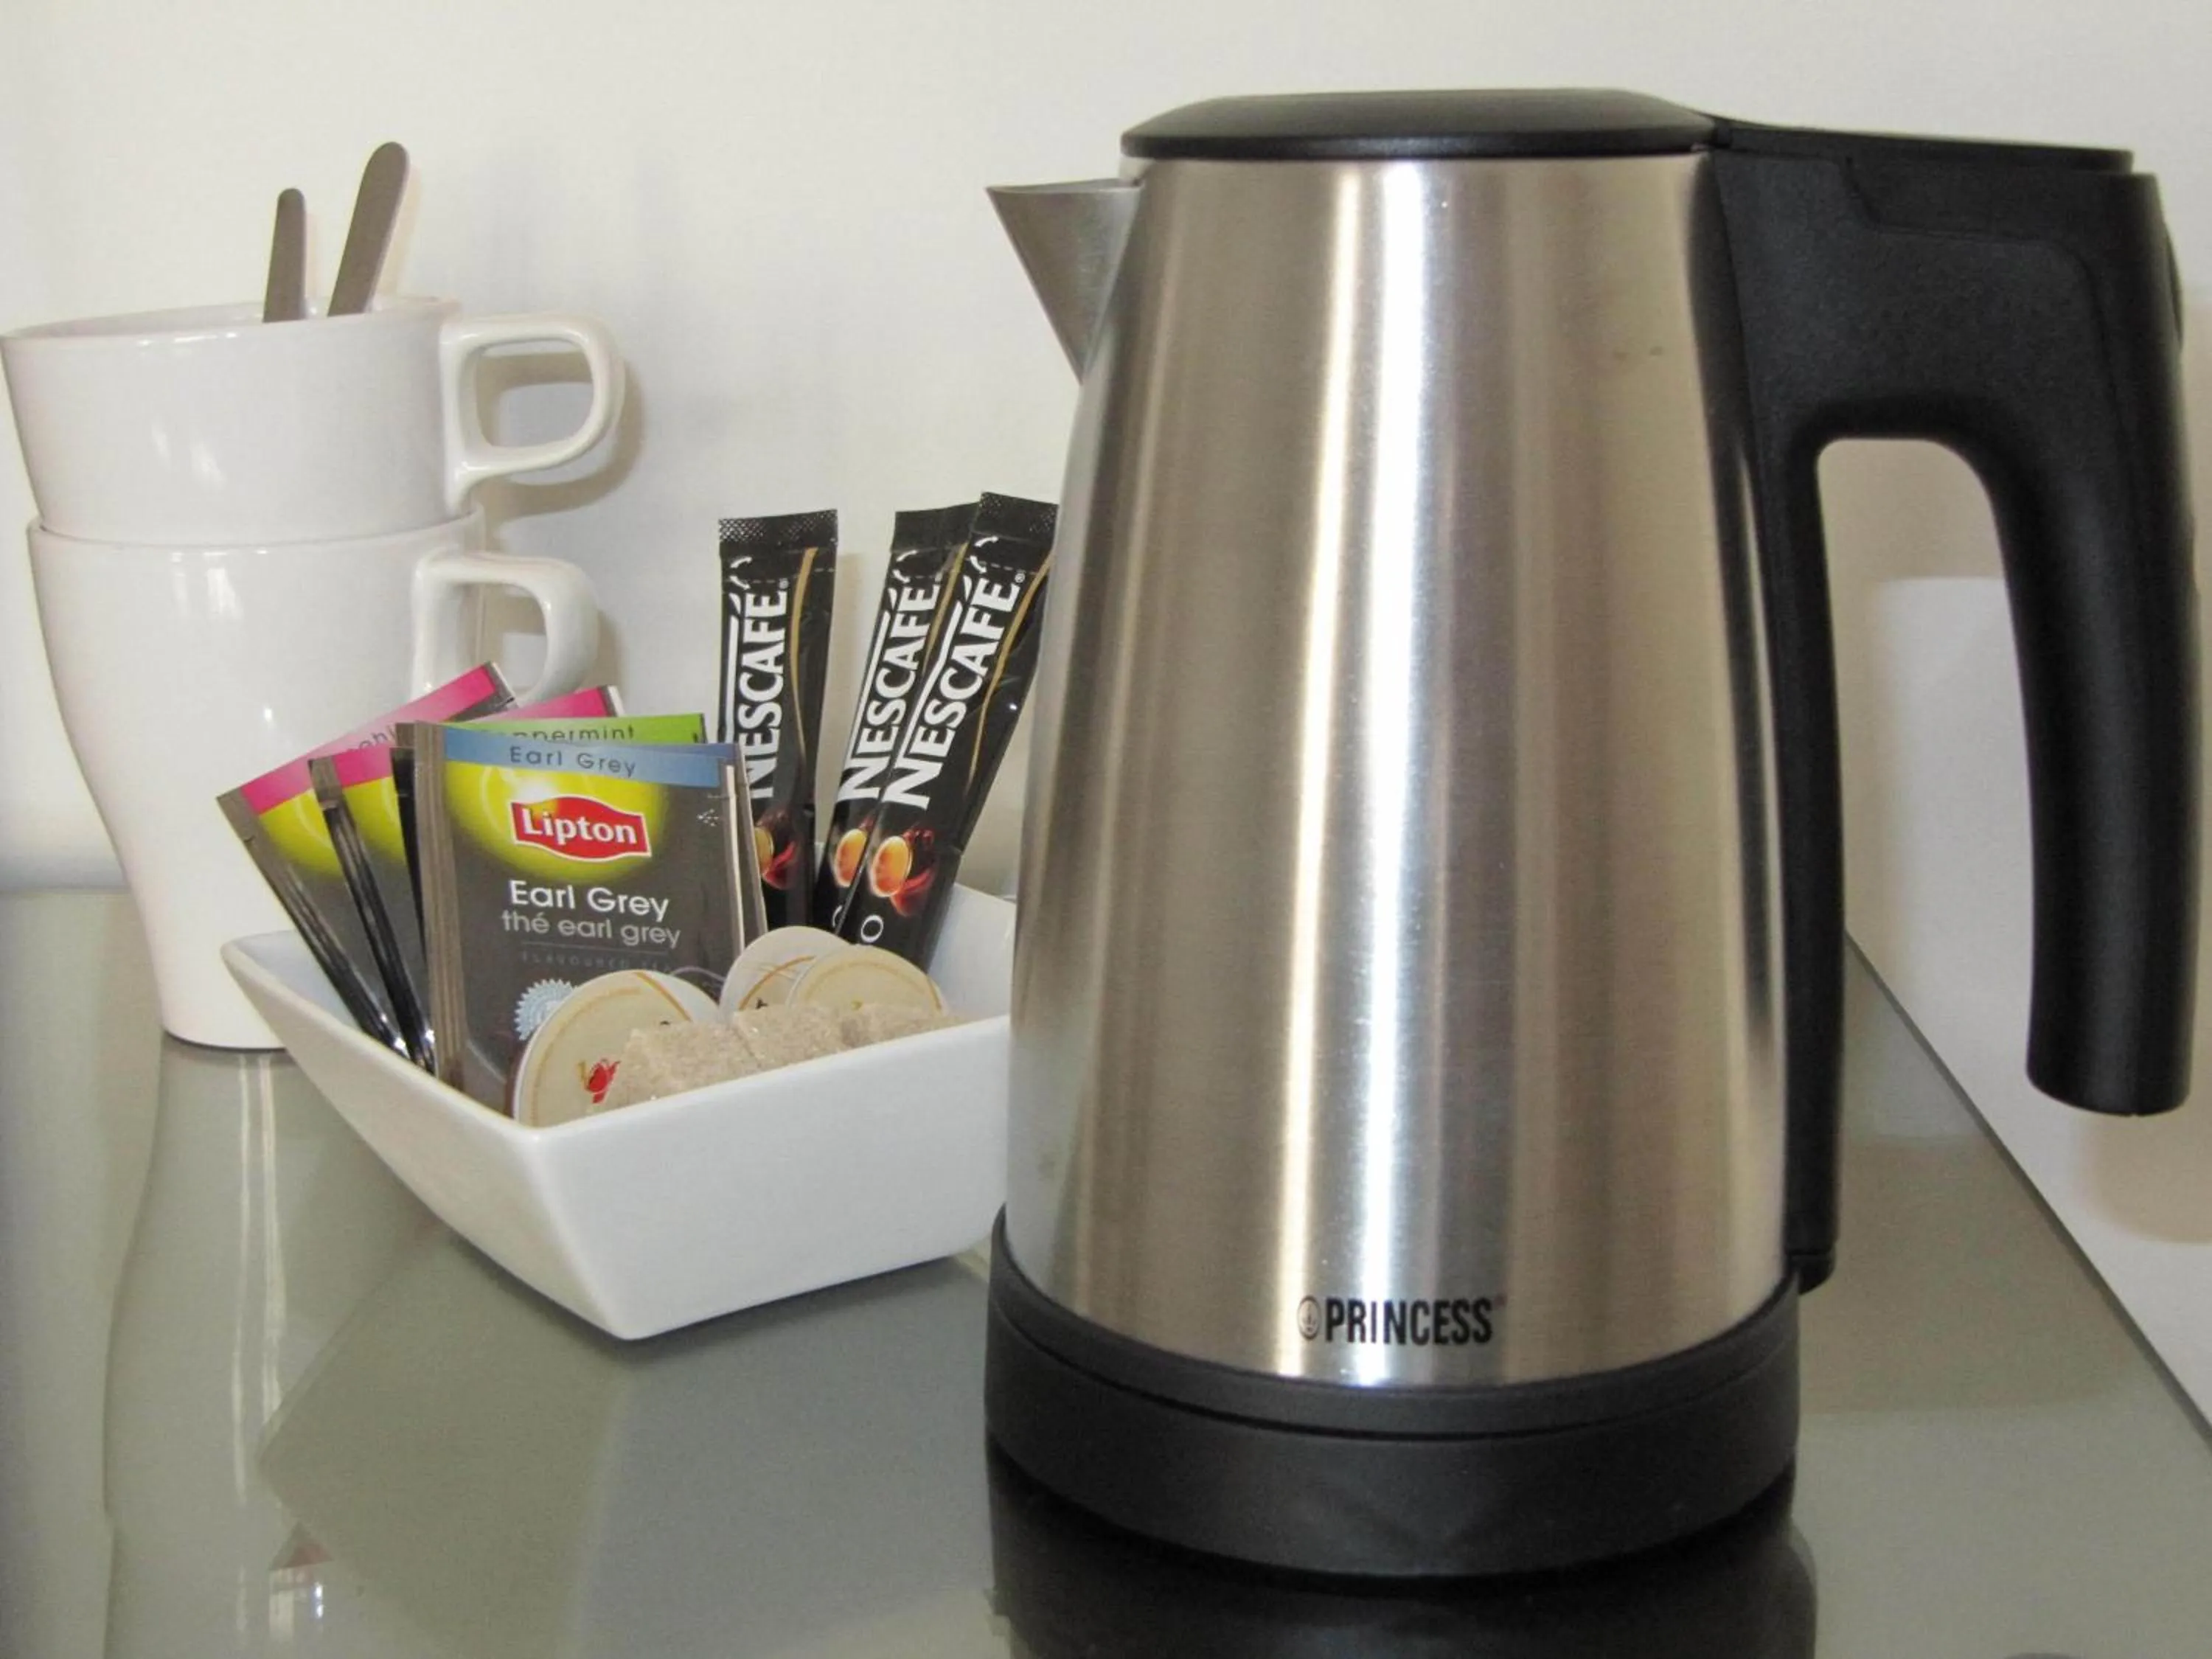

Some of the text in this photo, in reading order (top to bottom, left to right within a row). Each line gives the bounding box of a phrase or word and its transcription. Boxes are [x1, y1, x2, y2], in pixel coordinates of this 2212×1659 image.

[509, 745, 636, 776] Earl Grey
[521, 807, 637, 845] Lipton
[509, 879, 669, 922] Earl Grey
[501, 909, 681, 950] thé earl grey
[1324, 1295, 1493, 1346] PRINCESS
